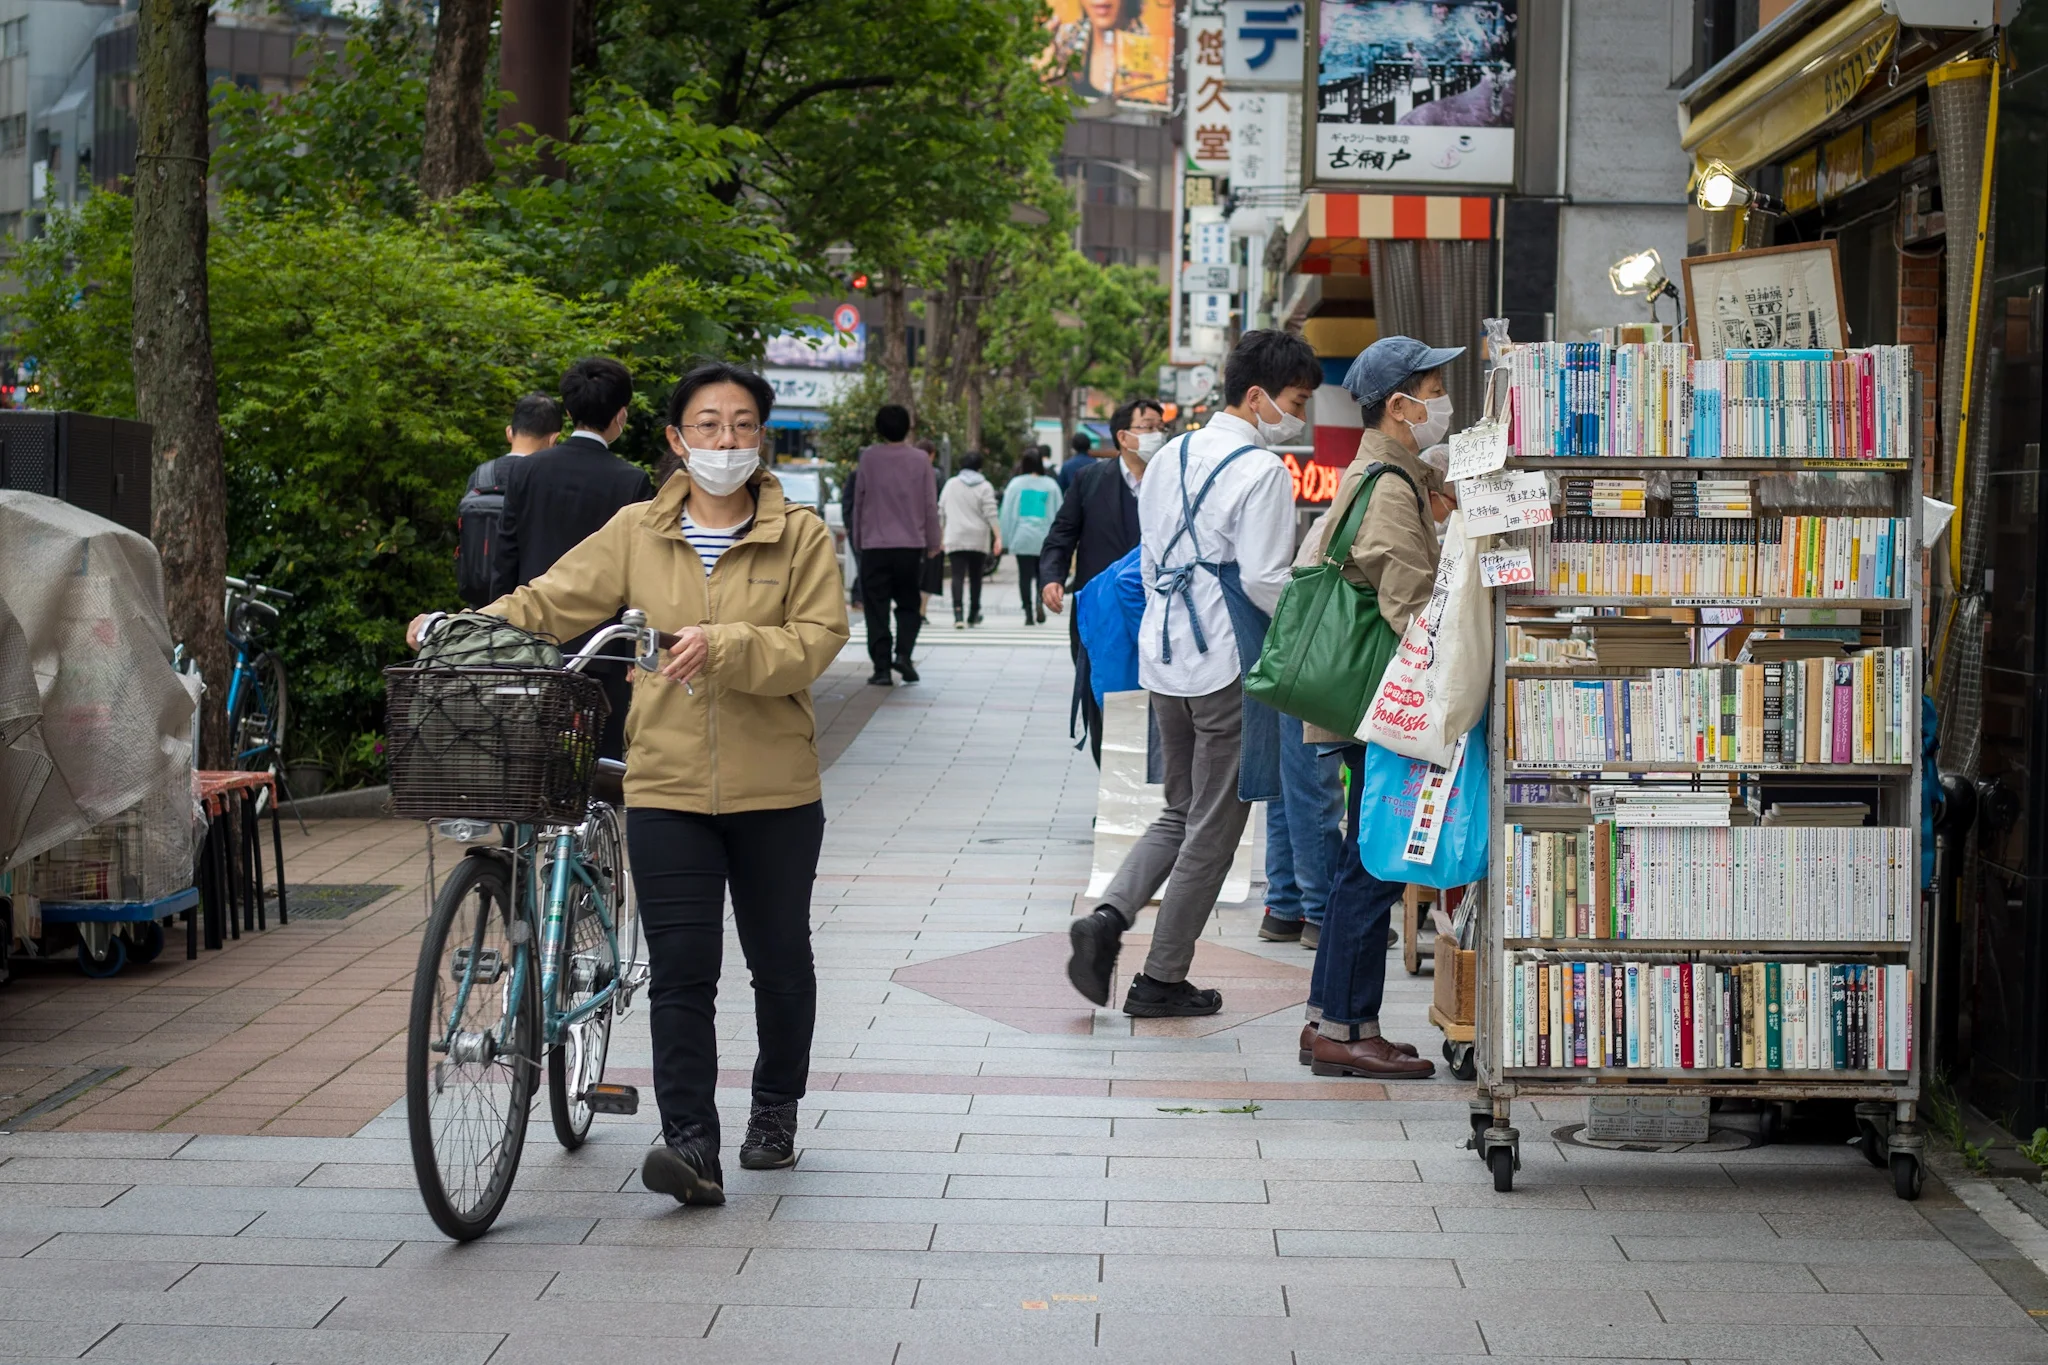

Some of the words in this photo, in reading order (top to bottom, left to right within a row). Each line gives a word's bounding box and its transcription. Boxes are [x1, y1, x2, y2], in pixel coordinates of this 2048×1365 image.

[1239, 4, 1302, 70] デ
[1196, 28, 1232, 161] 悠久堂
[1328, 145, 1412, 171] 古瀬戸
[1454, 432, 1500, 458] 紀行本
[1450, 451, 1494, 470] ガイドブック
[1461, 478, 1515, 498] 江戸川乱歩
[1506, 486, 1548, 503] 推理文庫
[1467, 504, 1500, 520] 大特価
[1497, 566, 1532, 585] 500
[1876, 650, 1885, 685] 映画の誕生
[1372, 697, 1430, 732] Bookish
[1599, 831, 1608, 882] ベートーヴェン
[1527, 965, 1535, 1026] 焼け跡のハイヒール
[1614, 968, 1623, 1019] 軍神の血脈
